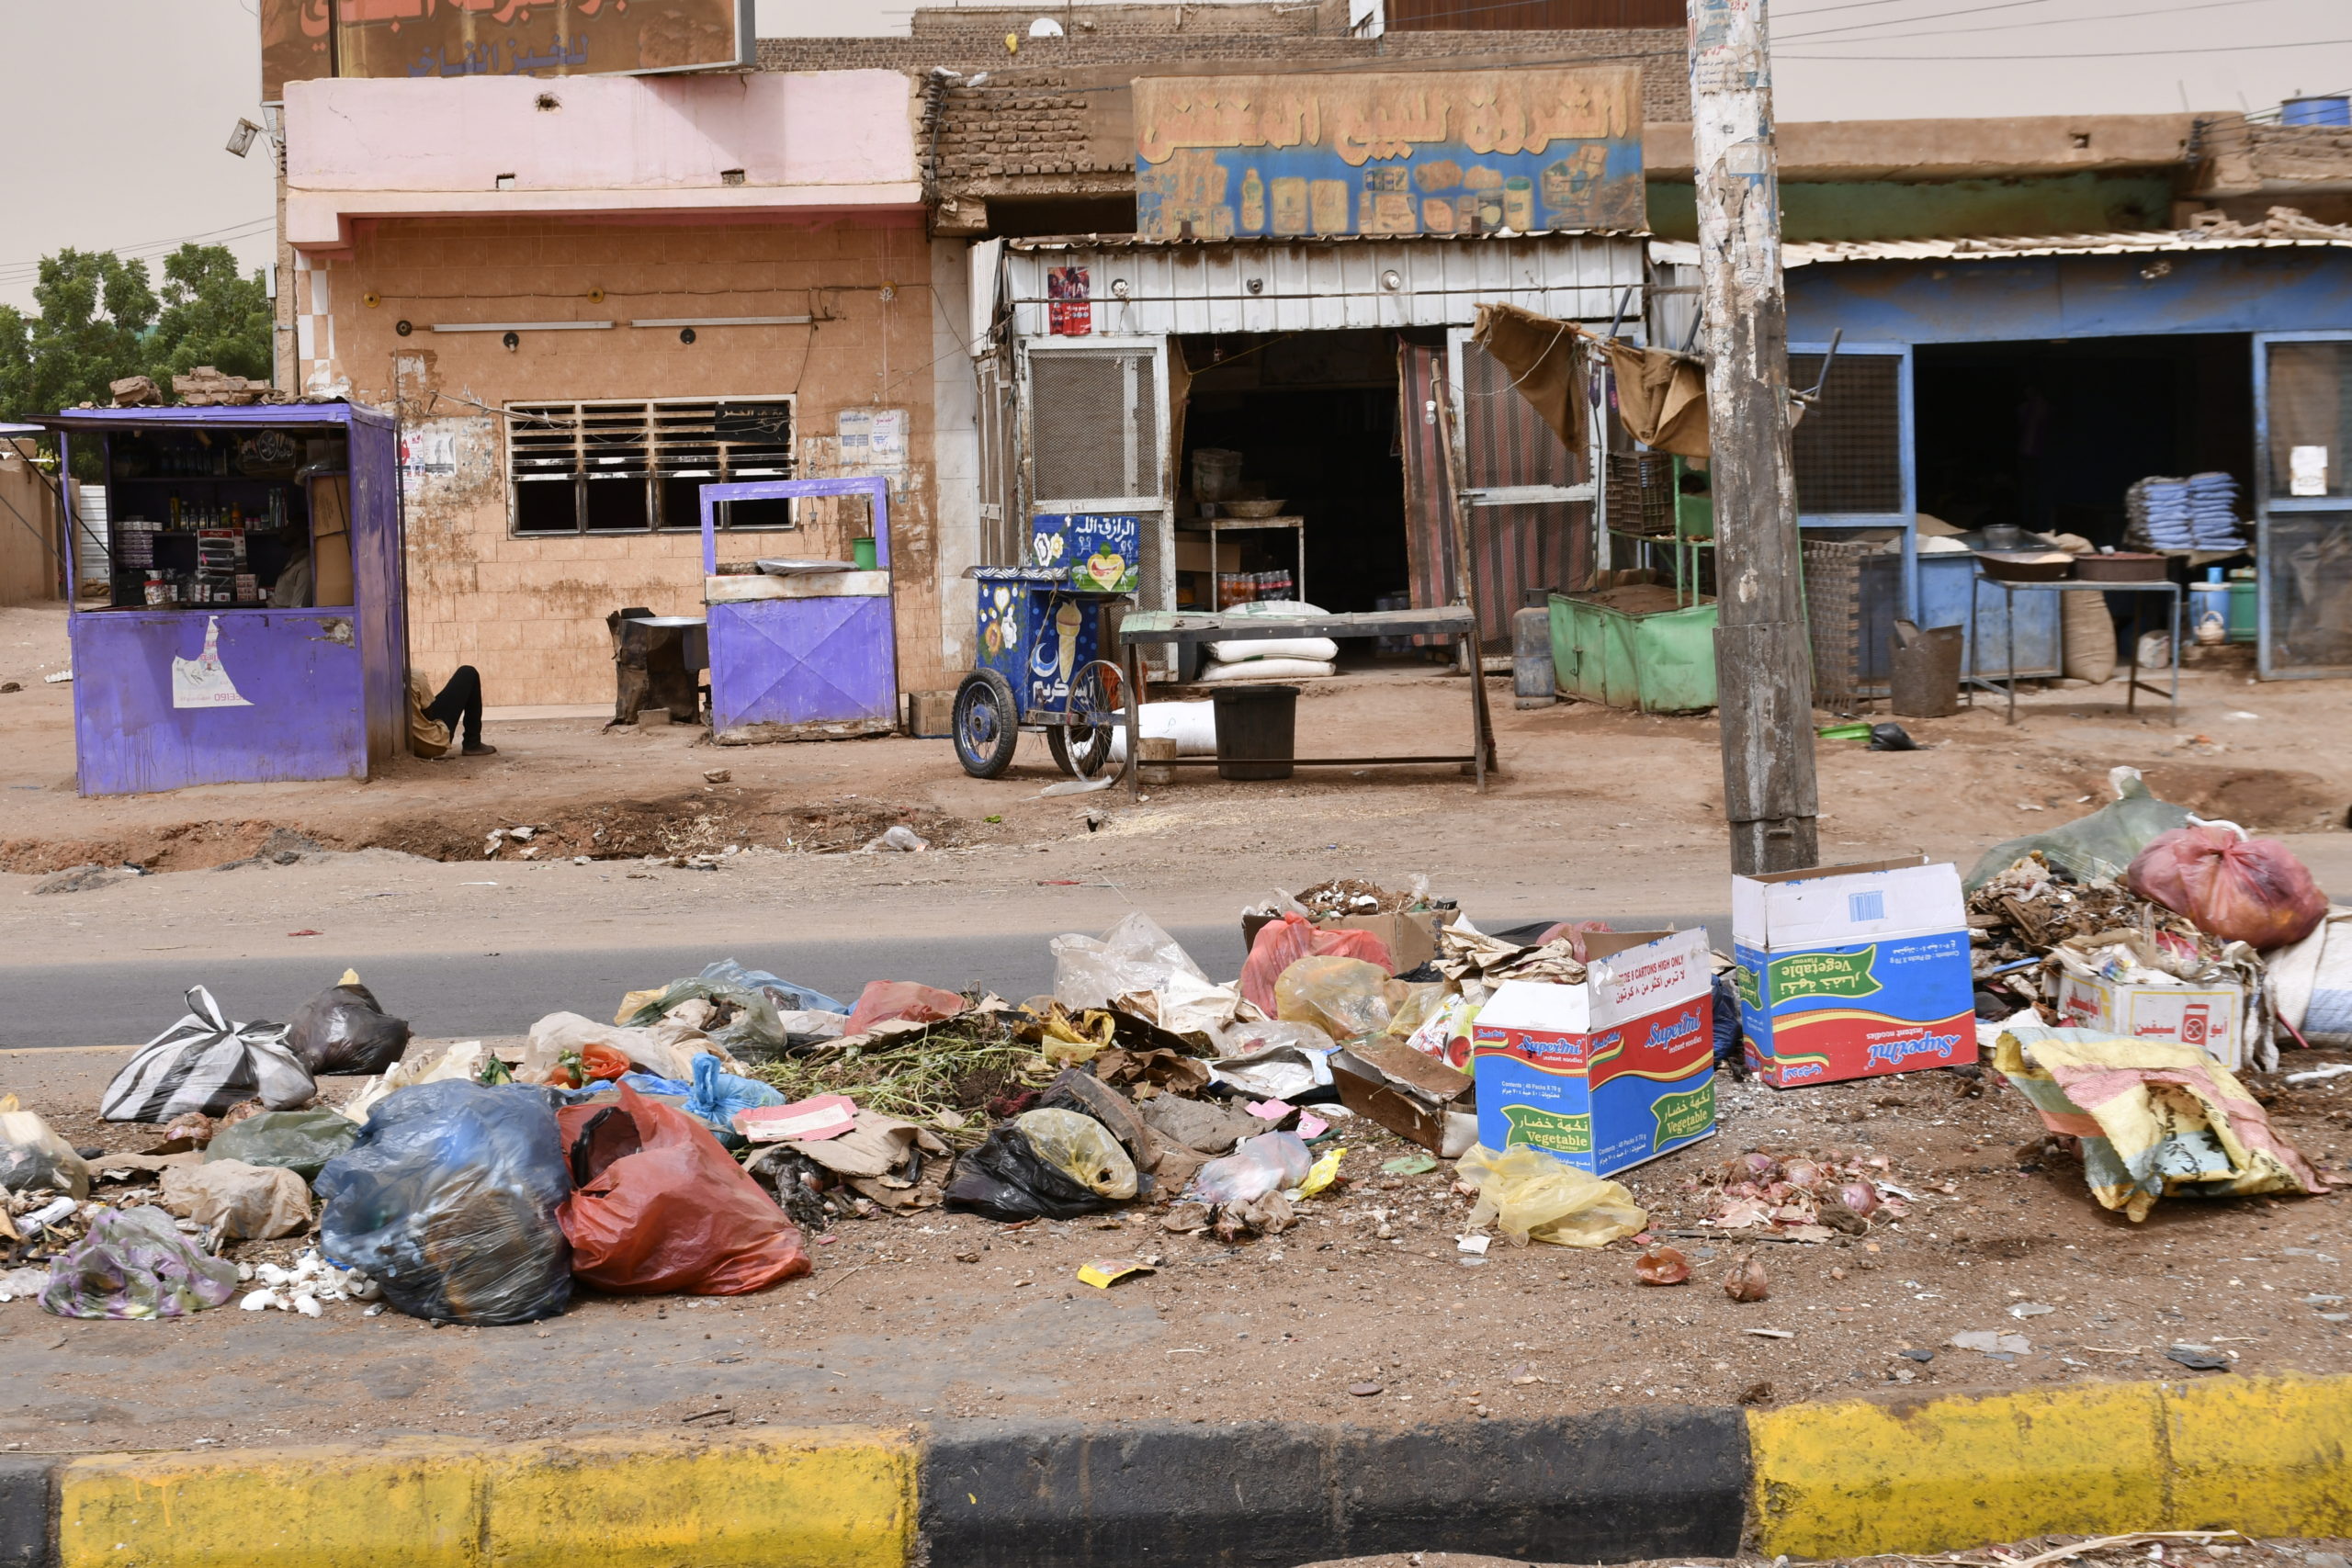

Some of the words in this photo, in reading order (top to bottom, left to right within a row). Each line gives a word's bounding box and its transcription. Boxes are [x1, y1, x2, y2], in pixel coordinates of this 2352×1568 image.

[407, 42, 499, 74] الفاخر
[504, 32, 589, 76] للخبز
[1334, 88, 1452, 167] للبيع
[1464, 83, 1628, 156] الثروة
[1075, 515, 1098, 533] الله
[1098, 513, 1135, 543] الرازق
[1635, 962, 1657, 979] CARTONS
[1657, 957, 1670, 972] HIGH
[1670, 953, 1684, 967] ONLY
[1679, 969, 1685, 980] لا
[1781, 958, 1852, 977] Vegetable
[1781, 978, 1816, 995] نكهة
[1820, 971, 1860, 990] خضار
[1866, 1030, 1895, 1040] noodles
[1896, 1027, 1924, 1037] instant
[1690, 1089, 1711, 1110] نكهة
[1519, 1114, 1555, 1129] خضار
[1663, 1100, 1689, 1122] خضار
[1667, 1109, 1708, 1134] Vegetable
[1556, 1117, 1589, 1133] نكهة
[1526, 1130, 1588, 1146] Vegetable
